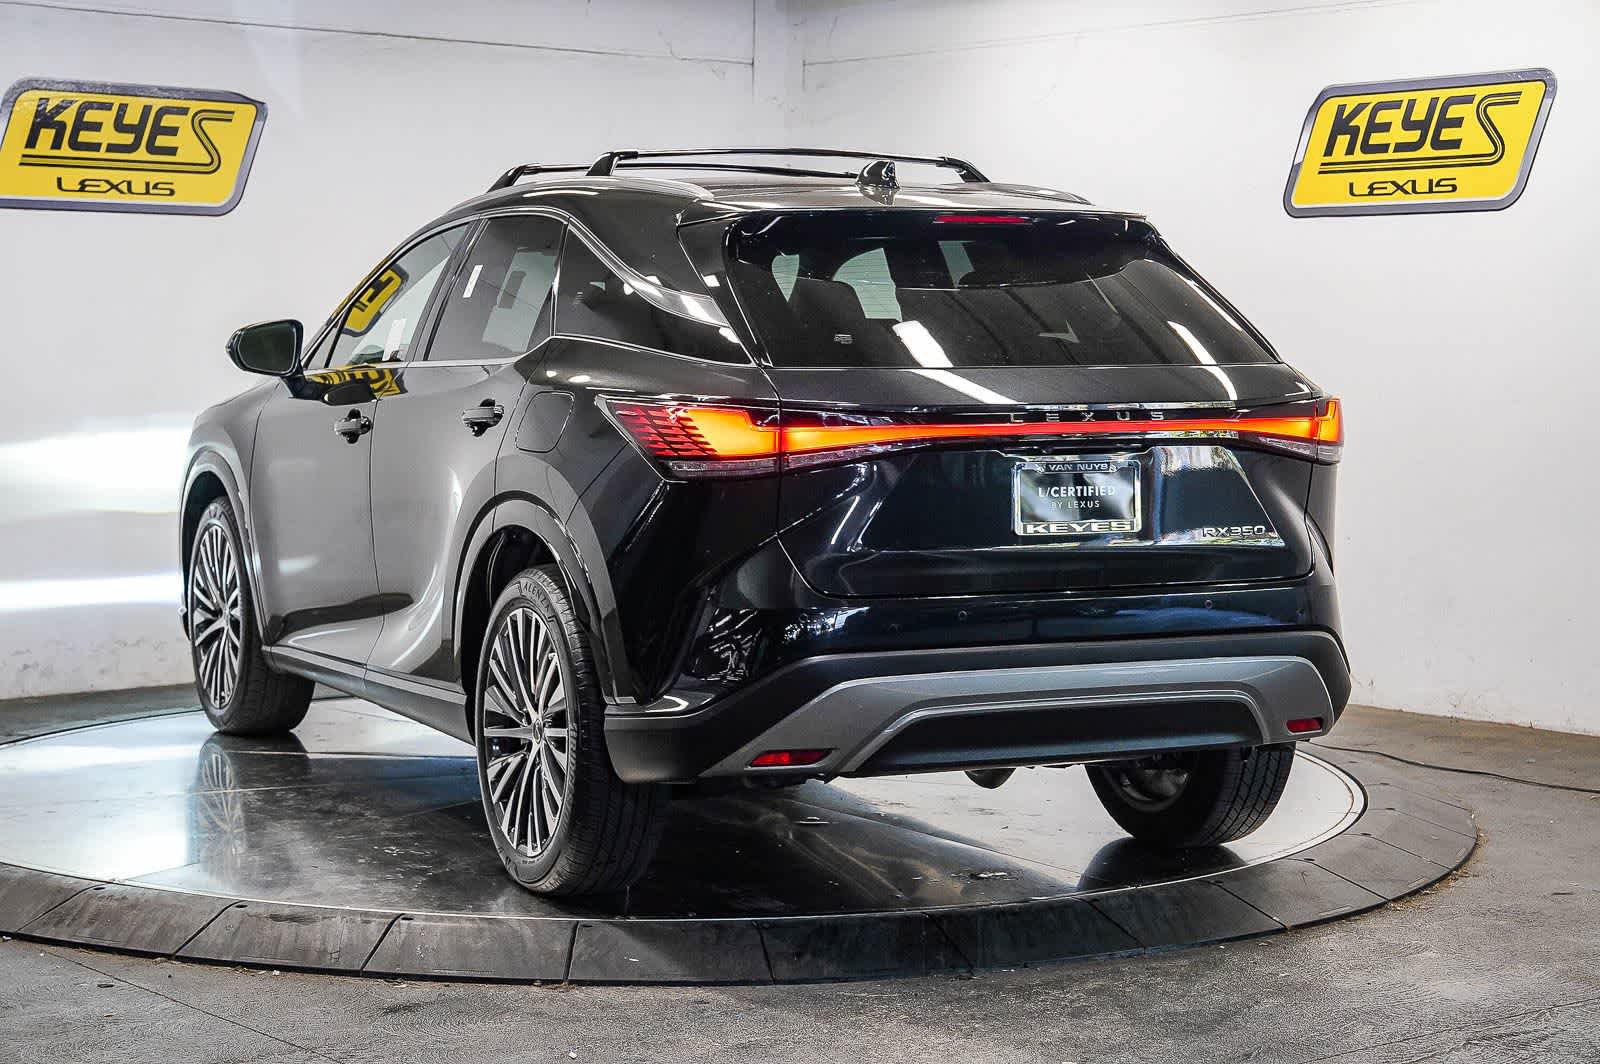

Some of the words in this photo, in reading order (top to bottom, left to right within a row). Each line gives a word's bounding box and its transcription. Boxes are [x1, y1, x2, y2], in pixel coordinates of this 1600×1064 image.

[20, 97, 235, 174] KEYES
[1319, 91, 1523, 173] KEYES
[56, 176, 176, 197] LEXUS
[1349, 177, 1458, 197] LEXUS
[1010, 411, 1165, 423] LEXUS
[1048, 463, 1073, 471] VAN
[1077, 462, 1109, 470] NUYS
[1038, 486, 1116, 498] L/CERTIFIED
[1051, 501, 1063, 509] BY
[1068, 500, 1101, 509] LEXUS
[1026, 521, 1132, 534] KEYES
